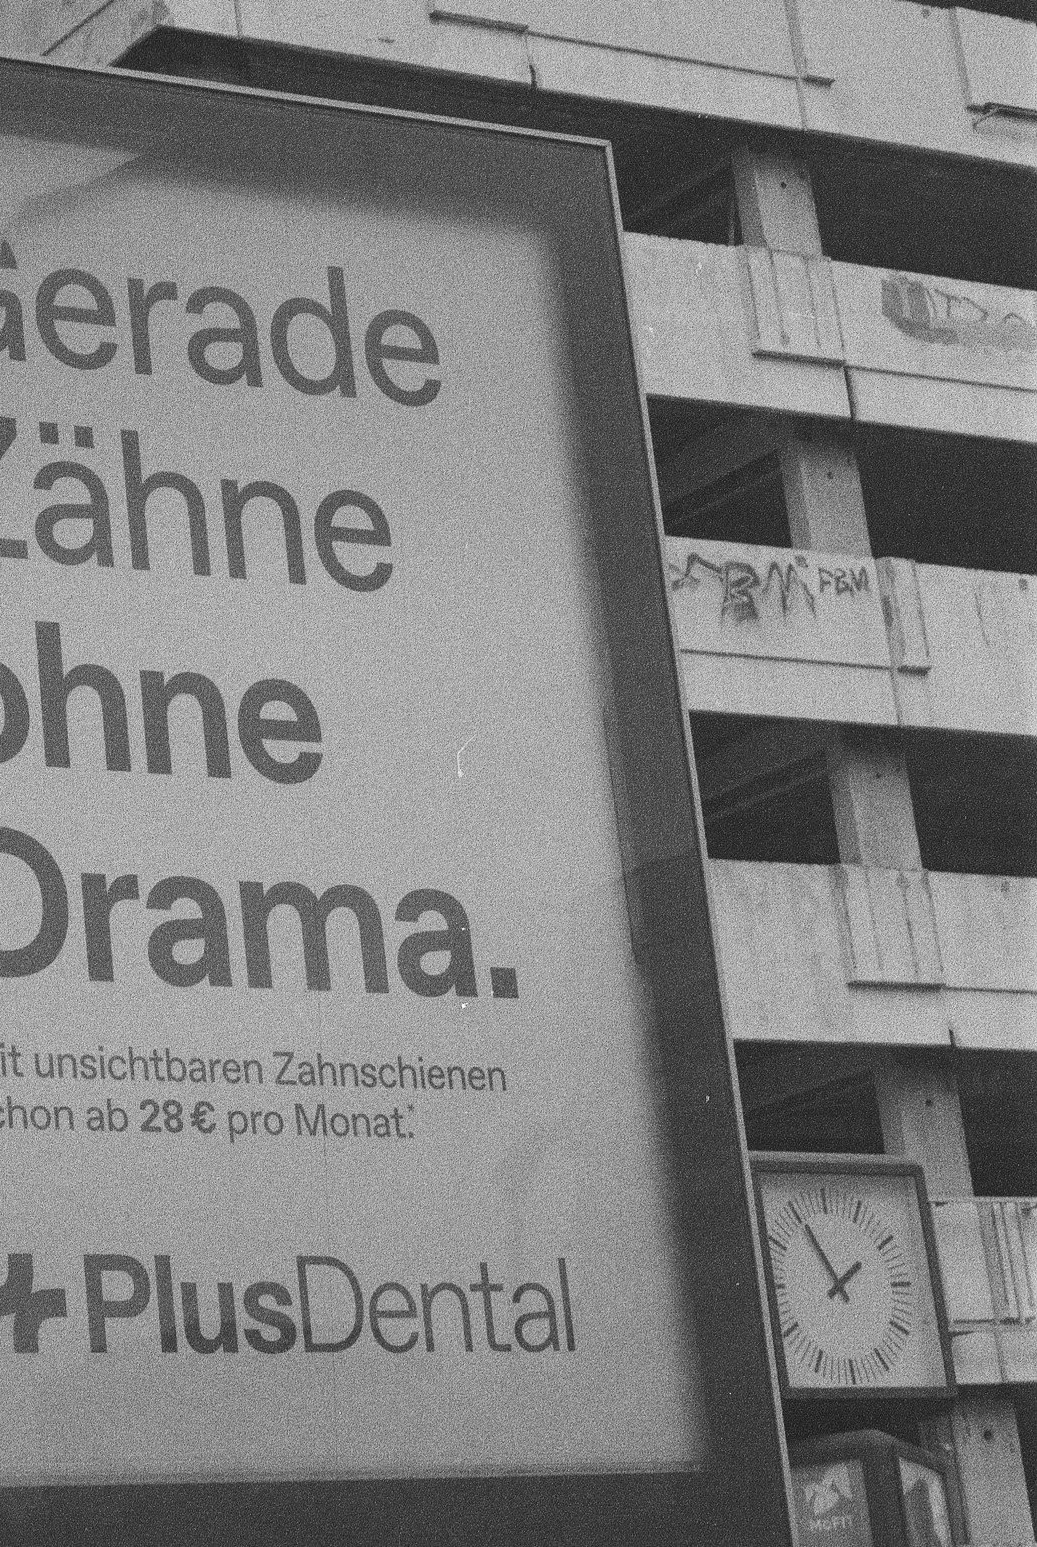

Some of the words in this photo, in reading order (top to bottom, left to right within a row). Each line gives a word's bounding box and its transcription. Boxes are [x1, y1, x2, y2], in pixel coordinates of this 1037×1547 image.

[33, 1045, 263, 1085] unsichtbaren
[273, 1050, 508, 1092] Zahnschienen
[86, 1098, 130, 1133] ab
[227, 1105, 285, 1143] pro
[83, 1254, 577, 1353] PlusDental
